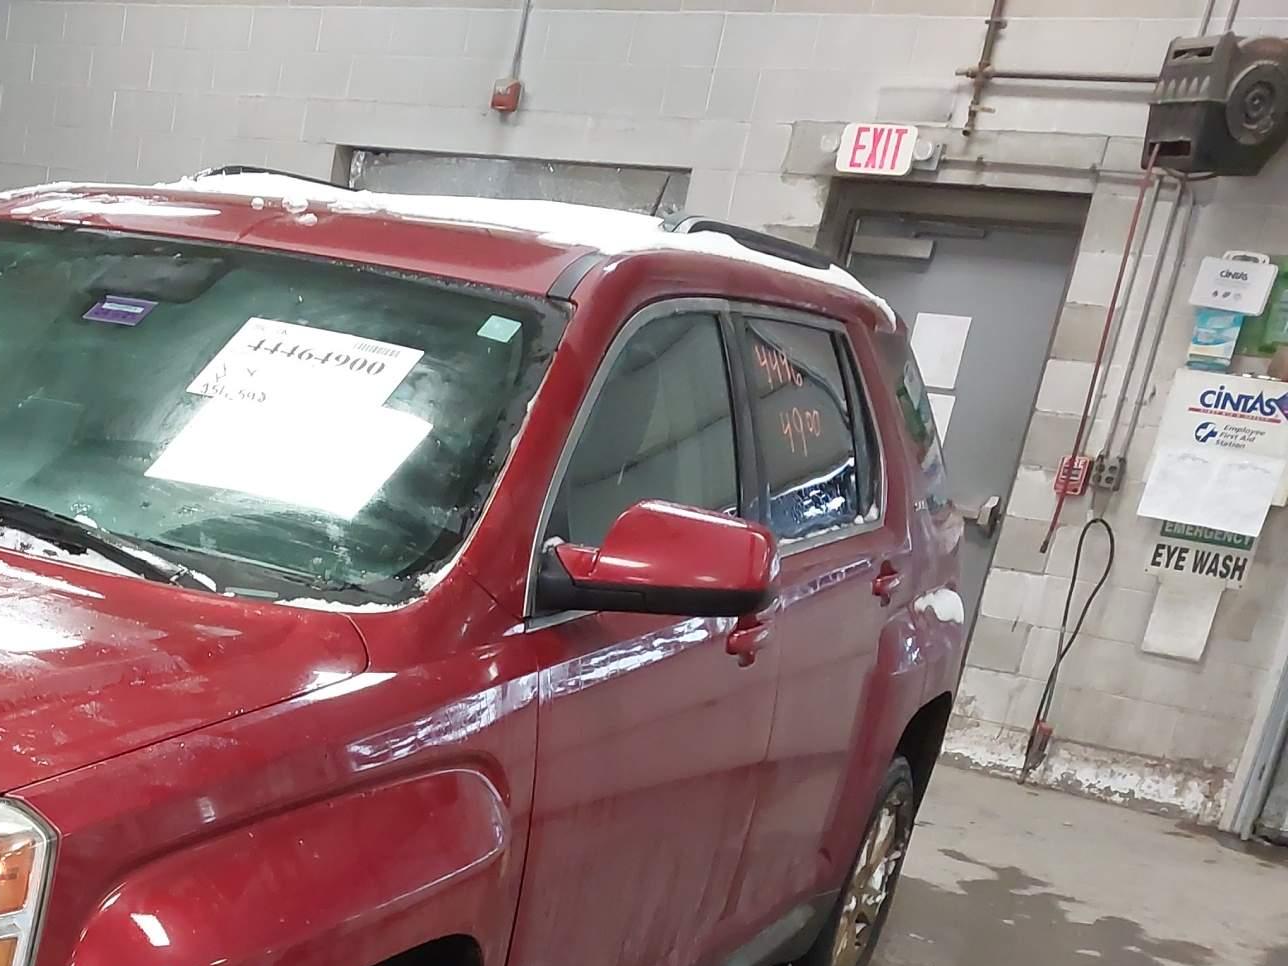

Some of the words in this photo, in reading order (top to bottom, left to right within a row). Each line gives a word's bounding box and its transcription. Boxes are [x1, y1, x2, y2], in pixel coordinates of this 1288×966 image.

[849, 127, 908, 170] EXIT
[1150, 543, 1190, 571] EYE
[1192, 549, 1248, 581] WASH
